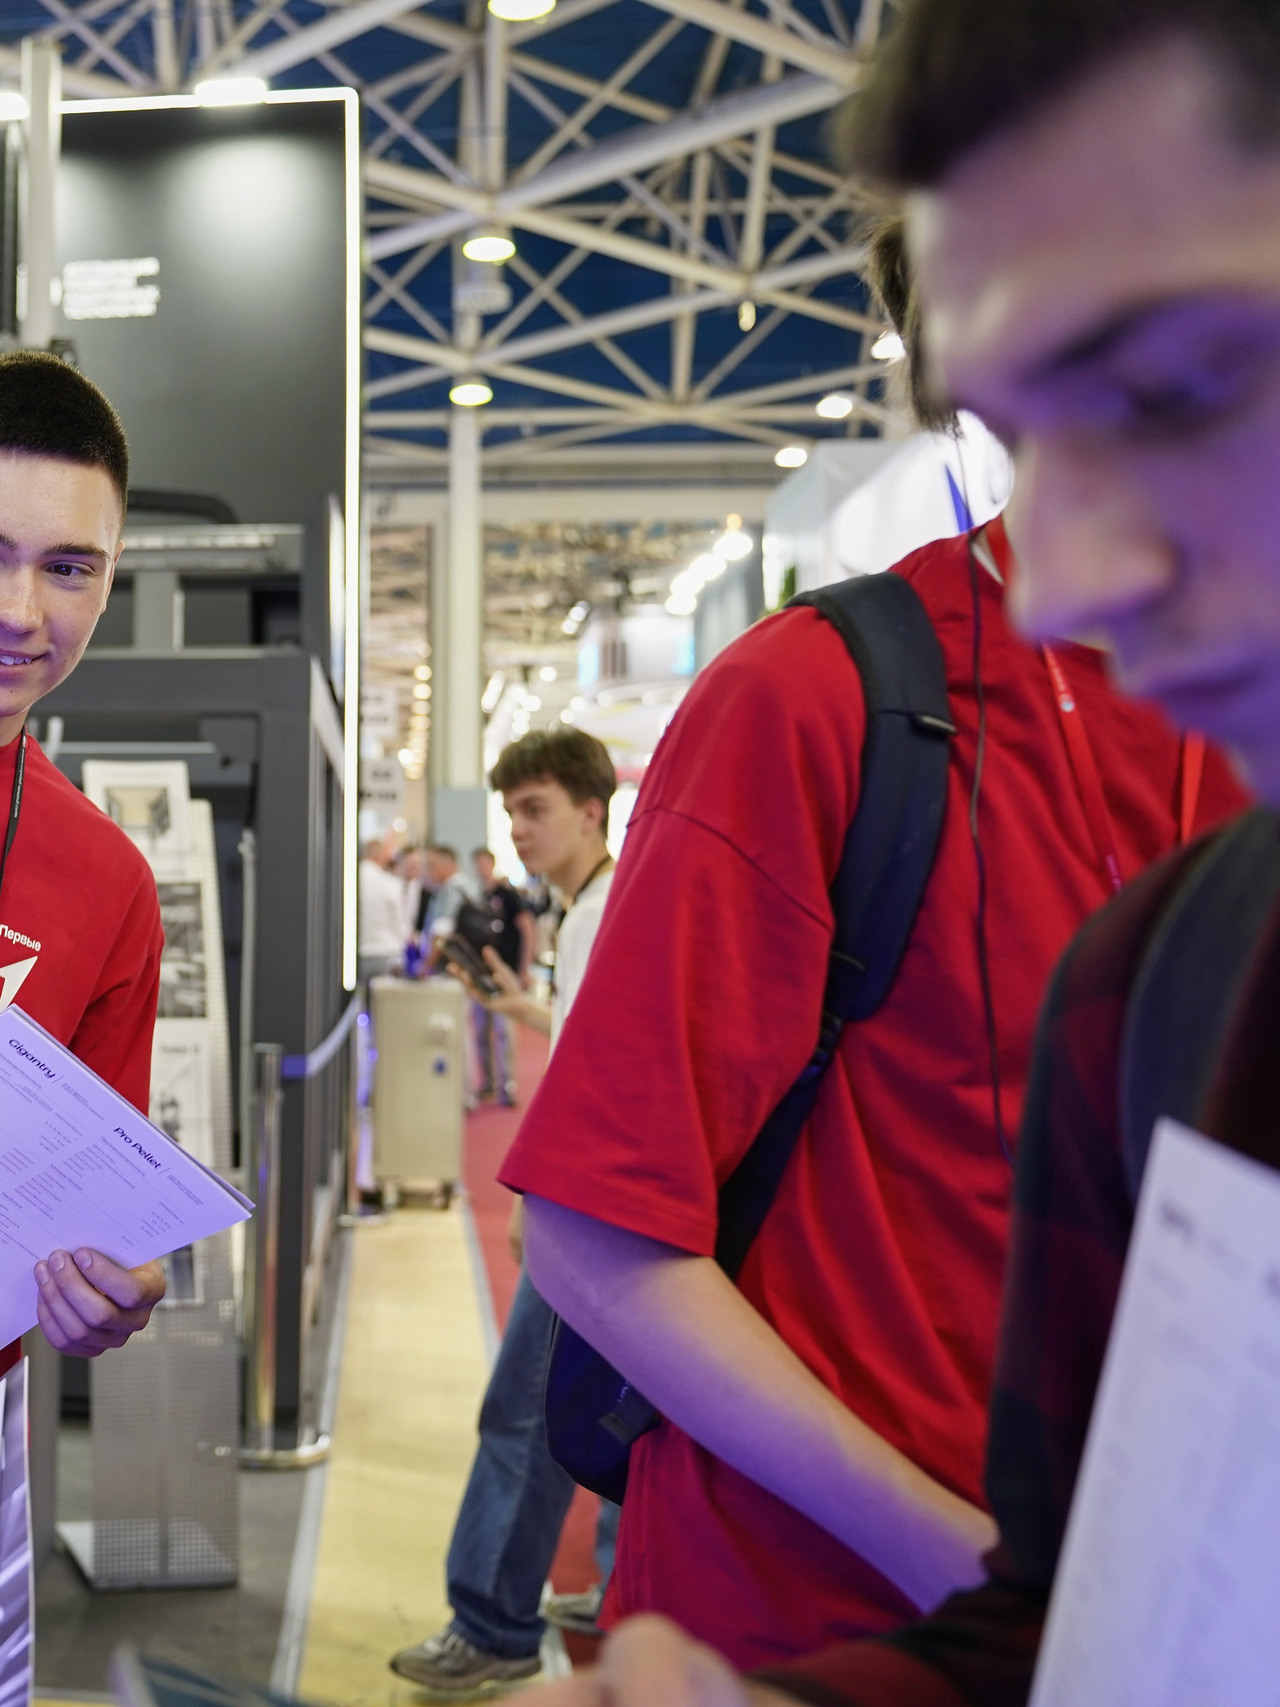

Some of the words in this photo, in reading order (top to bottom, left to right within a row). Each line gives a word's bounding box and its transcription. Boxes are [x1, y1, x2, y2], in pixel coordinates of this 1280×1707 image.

[8, 1038, 56, 1079] Gigantry
[113, 1126, 133, 1145] Pro
[131, 1142, 163, 1170] Pellet
